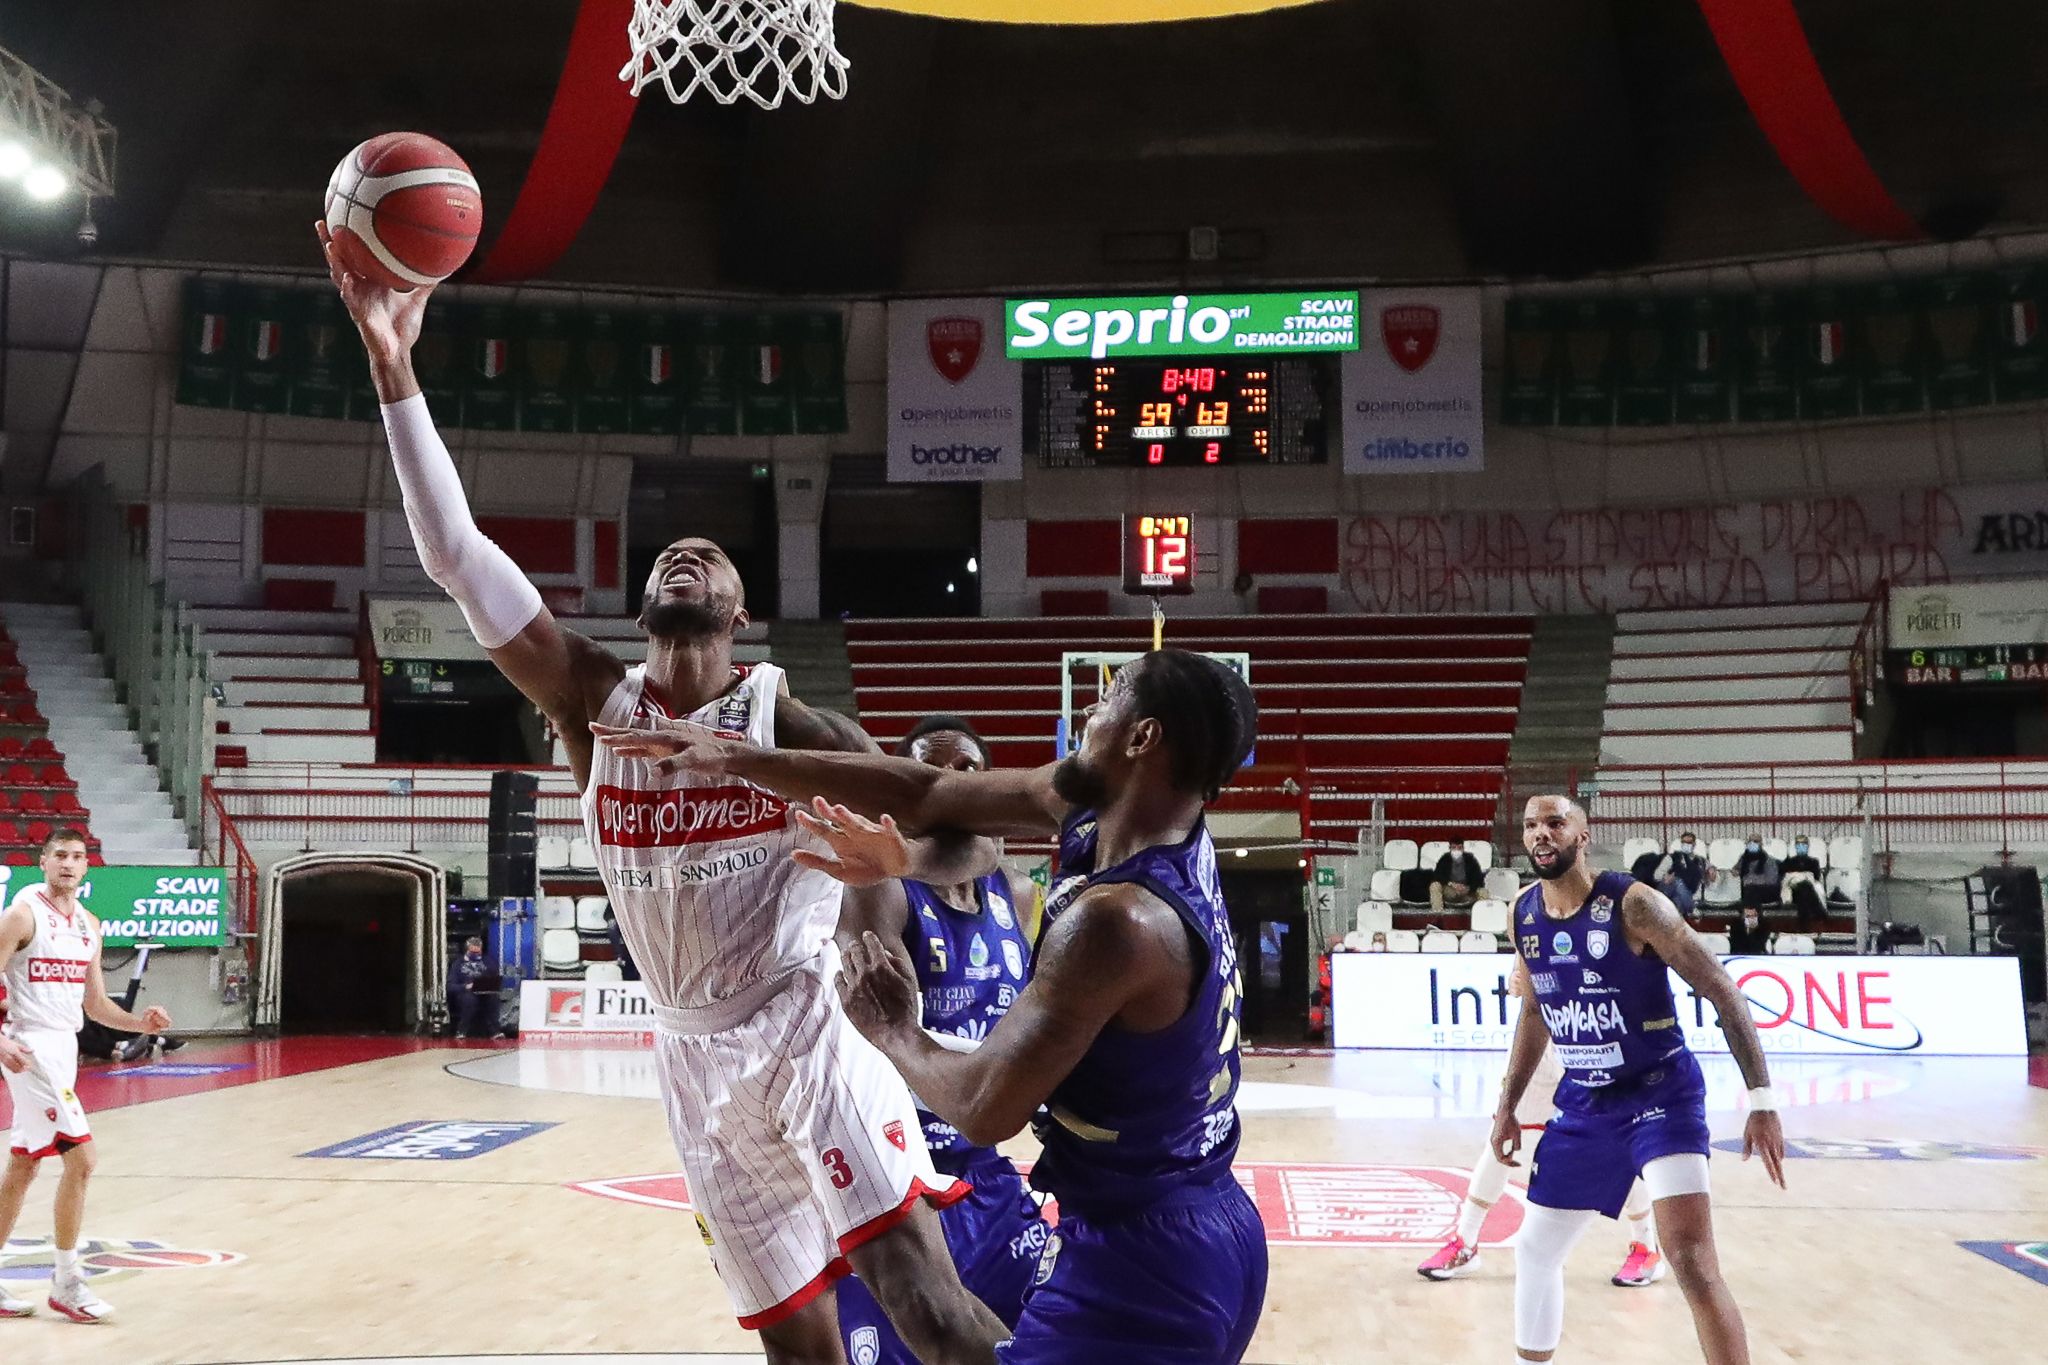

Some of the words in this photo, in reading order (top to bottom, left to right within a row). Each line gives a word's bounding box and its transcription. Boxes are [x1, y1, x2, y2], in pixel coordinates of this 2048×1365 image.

[1300, 299, 1354, 313] SCAVI
[1011, 295, 1231, 358] Seprio
[1230, 305, 1250, 319] srl
[1284, 315, 1354, 329] STRADE
[1234, 331, 1354, 347] DEMOLIZIONI
[1140, 403, 1172, 426] 59
[1197, 402, 1229, 425] 63
[1132, 427, 1177, 437] VARESE
[911, 443, 1002, 465] brother
[1148, 444, 1164, 464] 0
[1205, 443, 1219, 463] 2
[1363, 437, 1470, 461] cimberio
[1146, 537, 1186, 574] 12
[1911, 649, 1925, 667] 6
[382, 660, 394, 676] 5
[1906, 667, 1953, 684] BAR
[680, 846, 768, 883] SANPAOLO
[156, 877, 220, 895] SCAVI
[132, 899, 220, 916] STRADE
[48, 914, 57, 928] 5
[100, 919, 219, 937] MOLIZIONI
[929, 937, 948, 973] 5
[1521, 935, 1540, 959] 22
[1735, 970, 1894, 1031] ONE
[593, 1019, 656, 1028] SERRAMENT
[1558, 1045, 1616, 1056] TEMPORARY
[822, 1147, 854, 1190] 3
